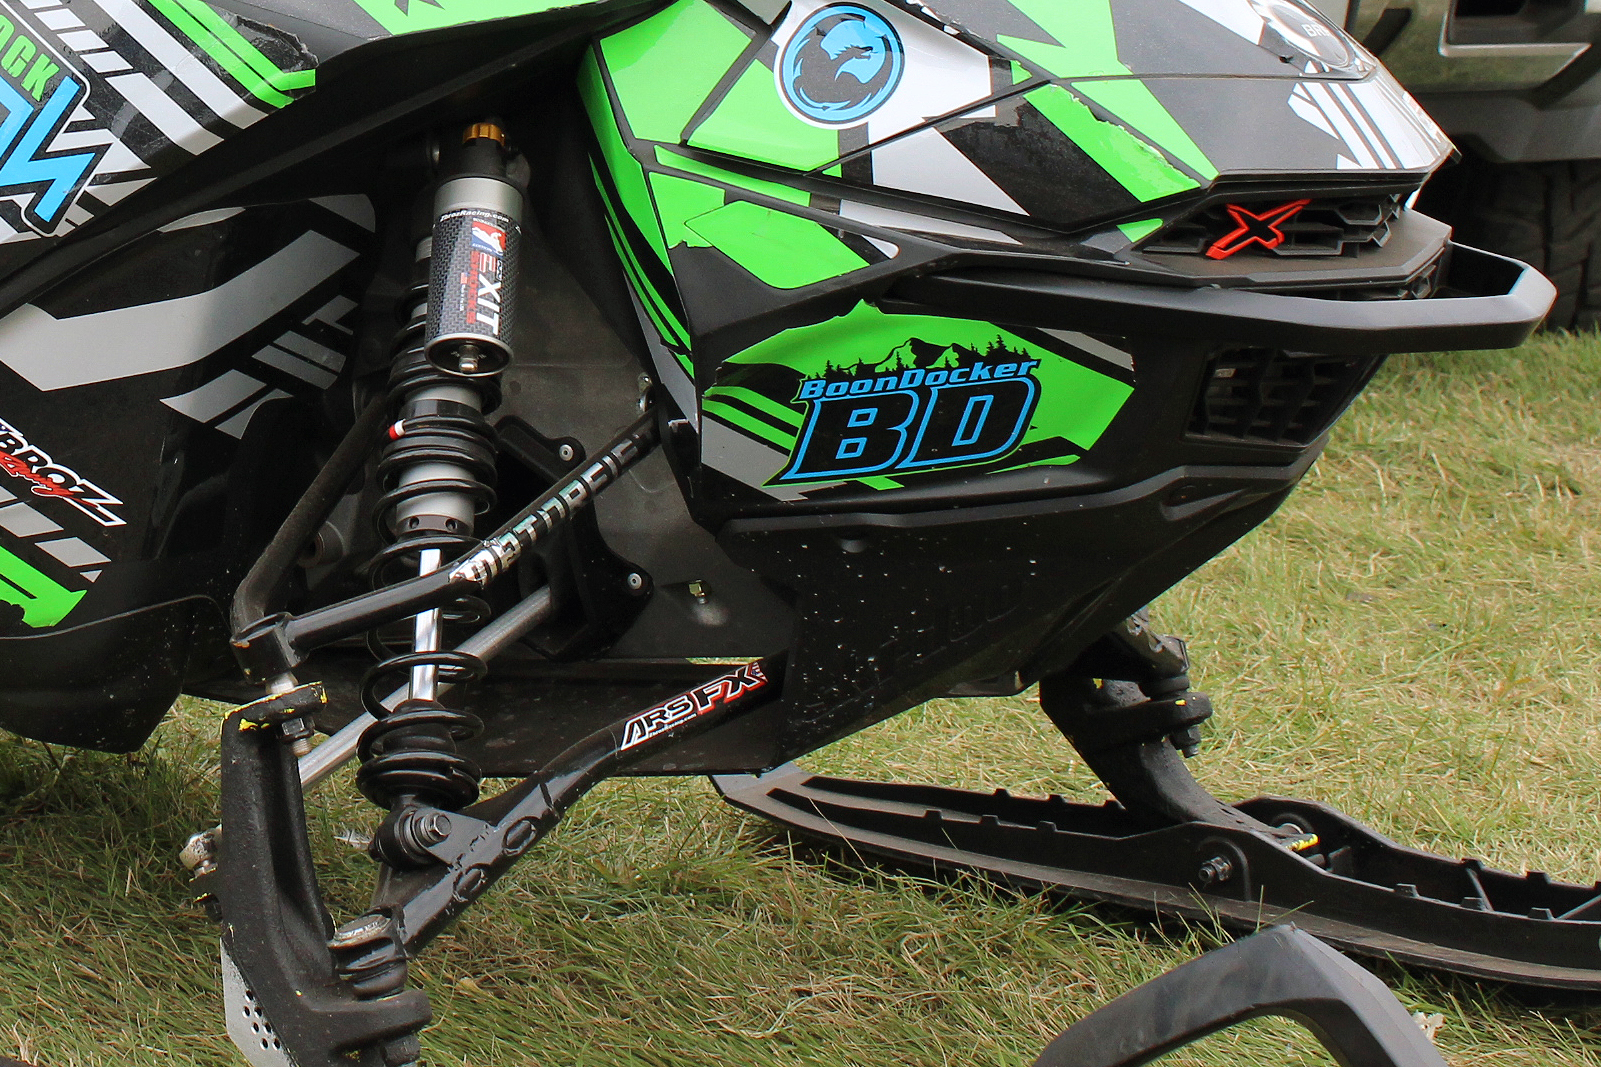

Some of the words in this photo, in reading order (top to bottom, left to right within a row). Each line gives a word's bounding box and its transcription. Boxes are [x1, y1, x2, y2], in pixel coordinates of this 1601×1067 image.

[476, 252, 501, 335] EXIT
[799, 359, 1039, 400] BoonDocker
[779, 376, 1036, 480] BD
